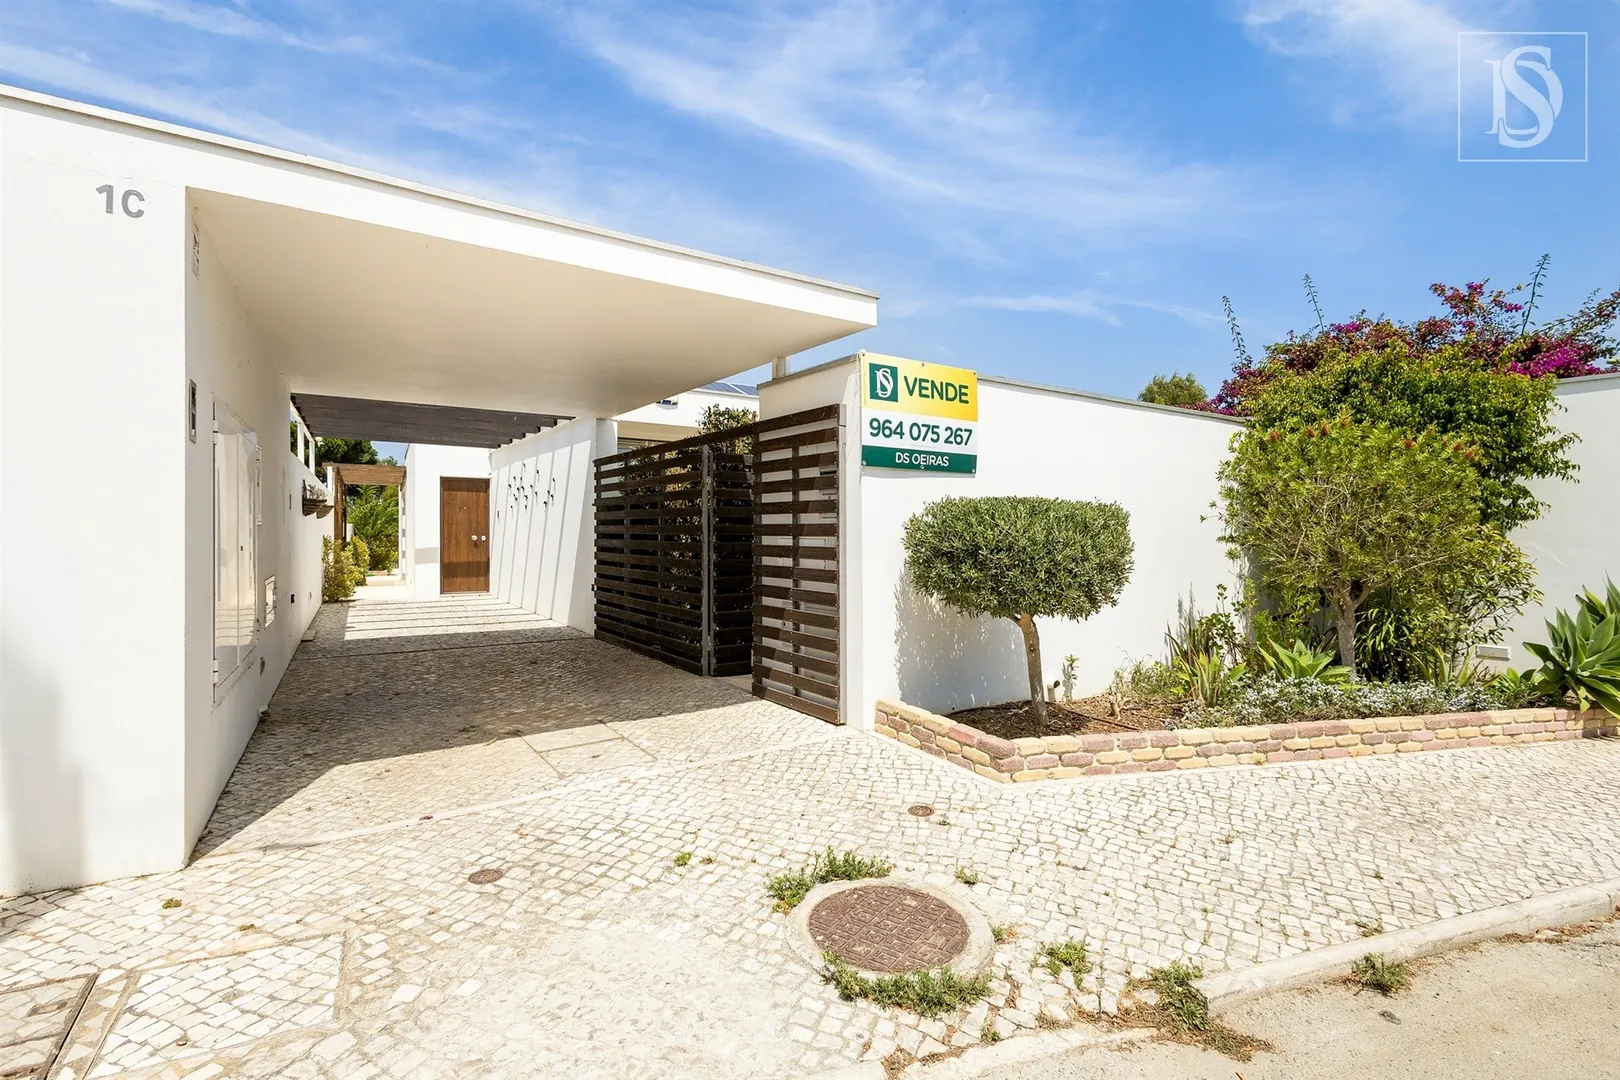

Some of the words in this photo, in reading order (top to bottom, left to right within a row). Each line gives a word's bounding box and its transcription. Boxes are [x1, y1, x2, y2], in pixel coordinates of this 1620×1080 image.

[95, 184, 145, 218] 1C
[904, 375, 969, 404] VENDE
[869, 418, 905, 440] 964
[909, 422, 940, 443] 075
[944, 426, 973, 446] 267
[895, 452, 910, 463] DS
[912, 454, 949, 466] OEIRAS
